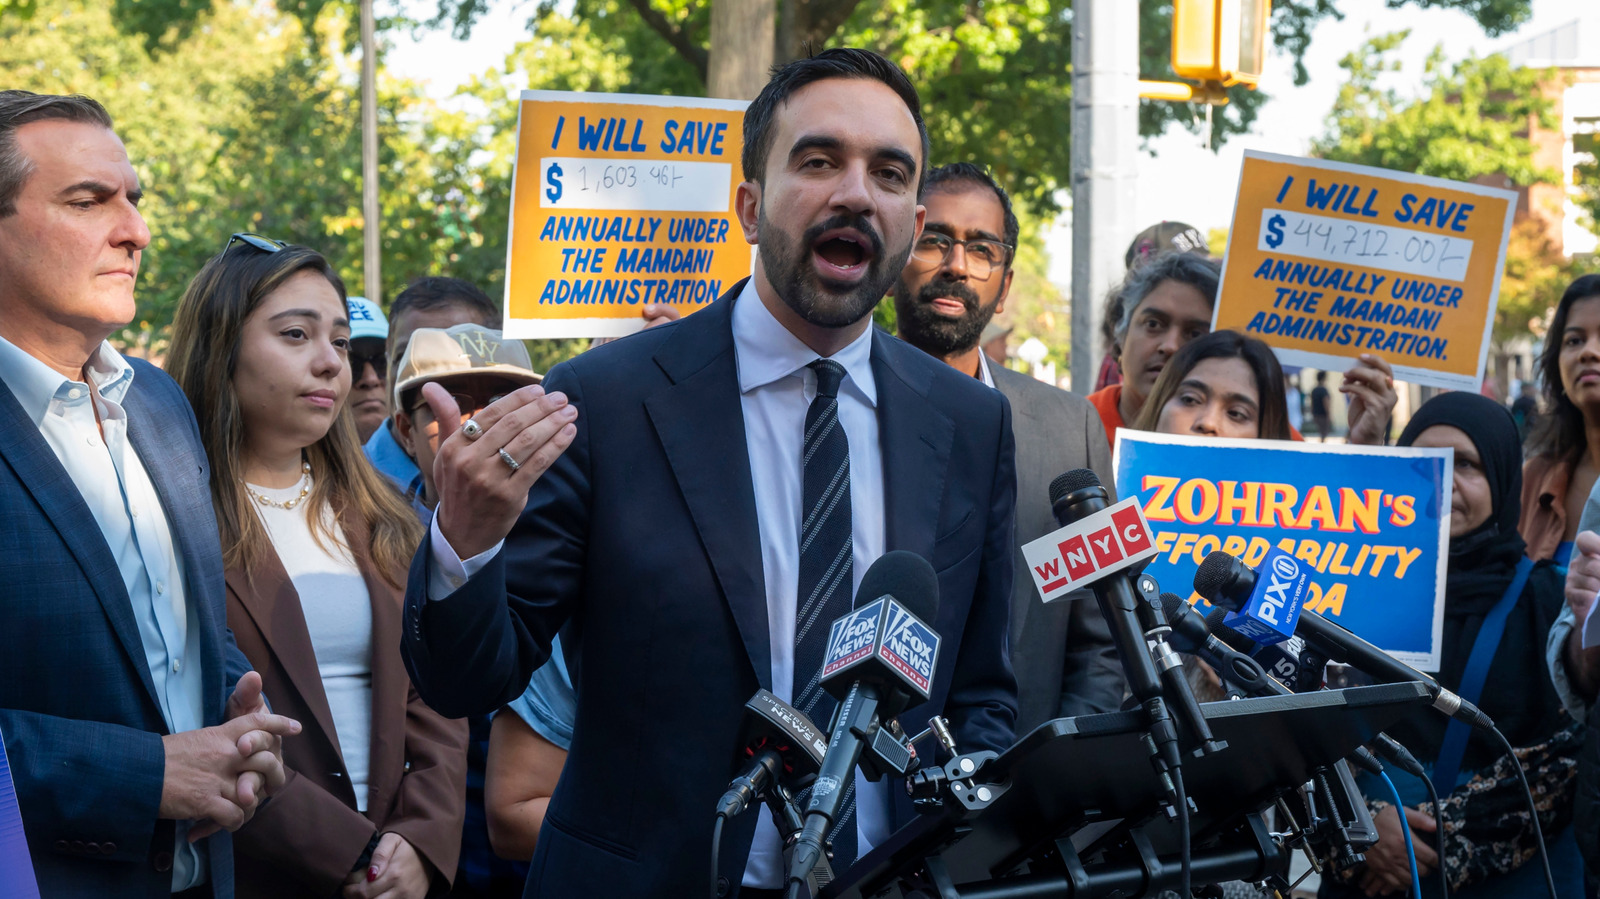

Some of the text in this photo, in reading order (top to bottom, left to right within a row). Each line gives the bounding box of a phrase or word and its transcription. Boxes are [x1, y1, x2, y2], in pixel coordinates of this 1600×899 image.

[551, 115, 728, 155] I WILL SAVE
[546, 162, 563, 204] $
[1276, 175, 1475, 232] I WILL SAVE
[539, 215, 730, 243] ANNUALLY UNDER
[1265, 213, 1286, 249] $
[561, 248, 714, 274] THE MAMDANI
[538, 278, 722, 305] ADMINISTRATION
[1253, 257, 1463, 309] ANNUALLY UNDER
[1273, 287, 1443, 332] THE MAMDANI
[1246, 311, 1448, 361] ADMINISTRATION.
[1034, 523, 1142, 581] WNYC
[1150, 530, 1423, 580] FFORDBILITY
[833, 630, 875, 660] NEWS
[845, 614, 878, 642] FOX
[902, 626, 933, 662] FOX
[825, 646, 872, 673] channel
[882, 650, 927, 688] channel
[890, 635, 930, 677] NEWS
[761, 695, 815, 737] SPECTRUM
[770, 706, 812, 742] NEWS
